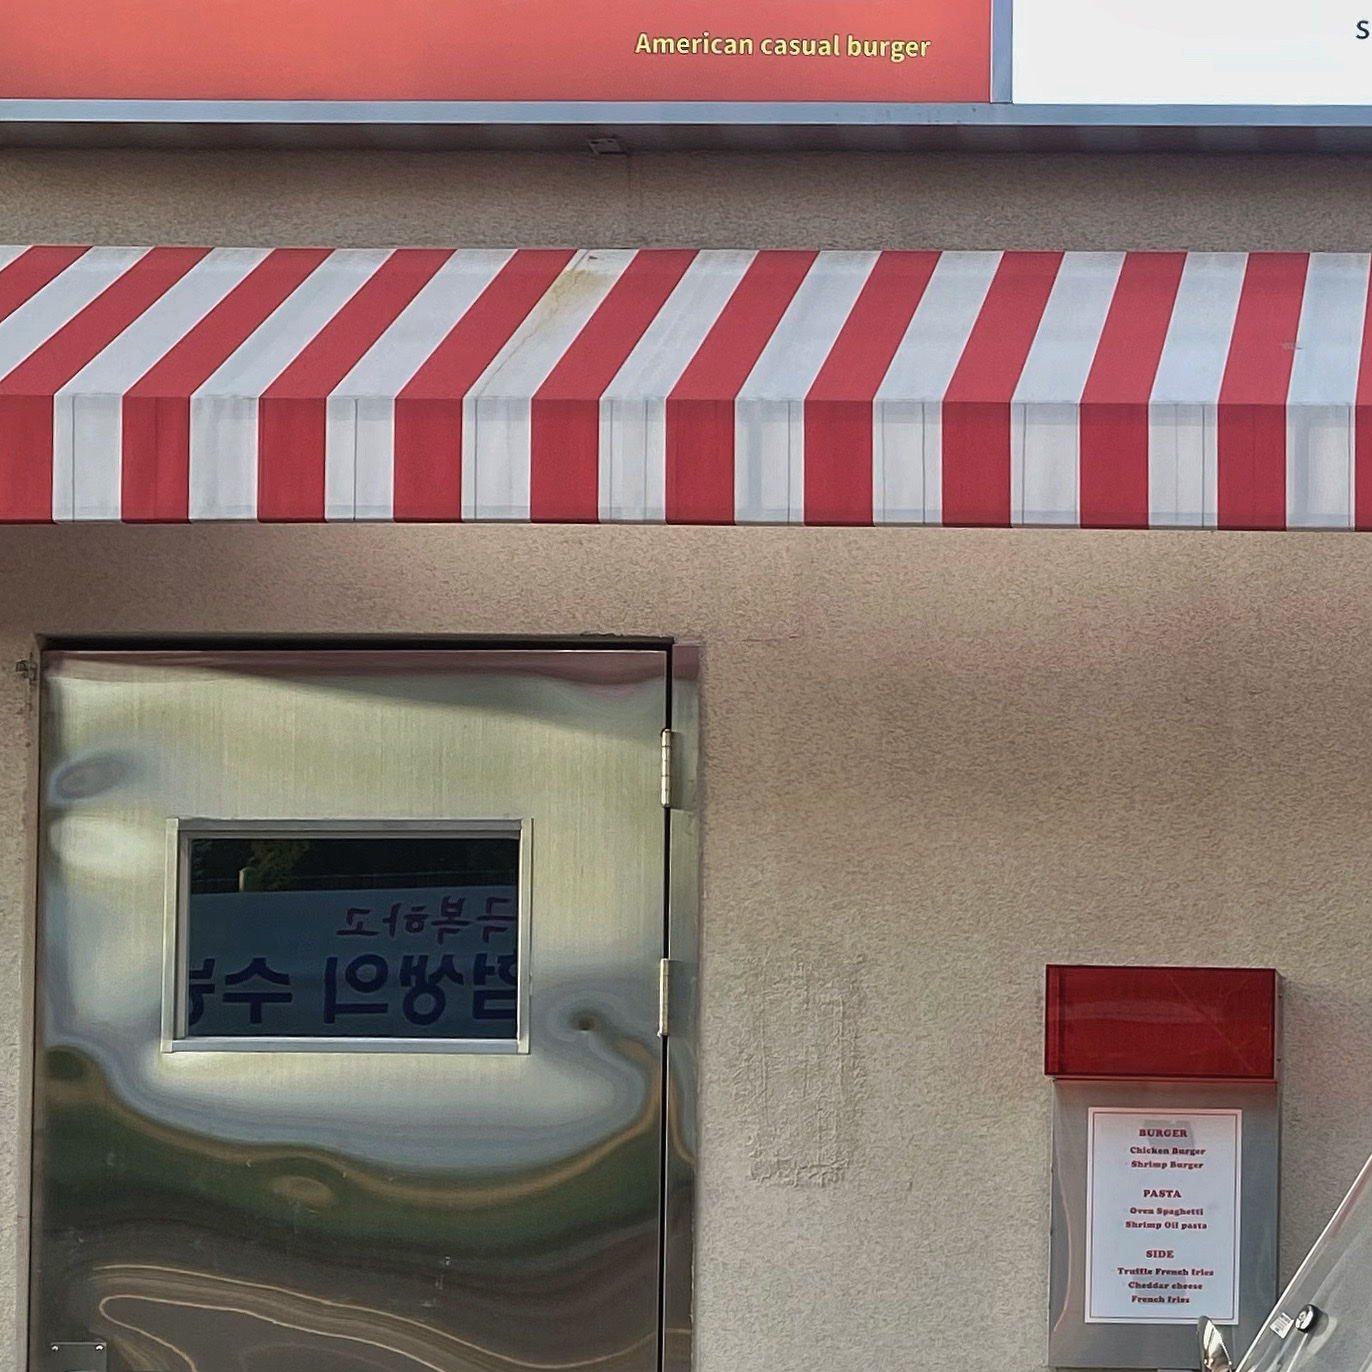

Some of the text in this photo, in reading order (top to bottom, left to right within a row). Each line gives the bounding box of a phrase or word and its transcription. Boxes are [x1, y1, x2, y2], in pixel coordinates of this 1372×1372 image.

[635, 32, 931, 63] American casual burger
[1138, 1129, 1188, 1138] BURGER
[1171, 1148, 1206, 1156] Burger
[1131, 1161, 1204, 1169] Shrimp Burger
[1143, 1190, 1182, 1198] PASTA
[1125, 1221, 1162, 1230] Shrimp
[1181, 1222, 1207, 1230] pasta
[1146, 1250, 1174, 1258] SIDE
[1117, 1267, 1153, 1276] Truffle
[1155, 1268, 1189, 1276] French
[1128, 1281, 1169, 1289] Cheddar
[1131, 1296, 1190, 1304] French fries
